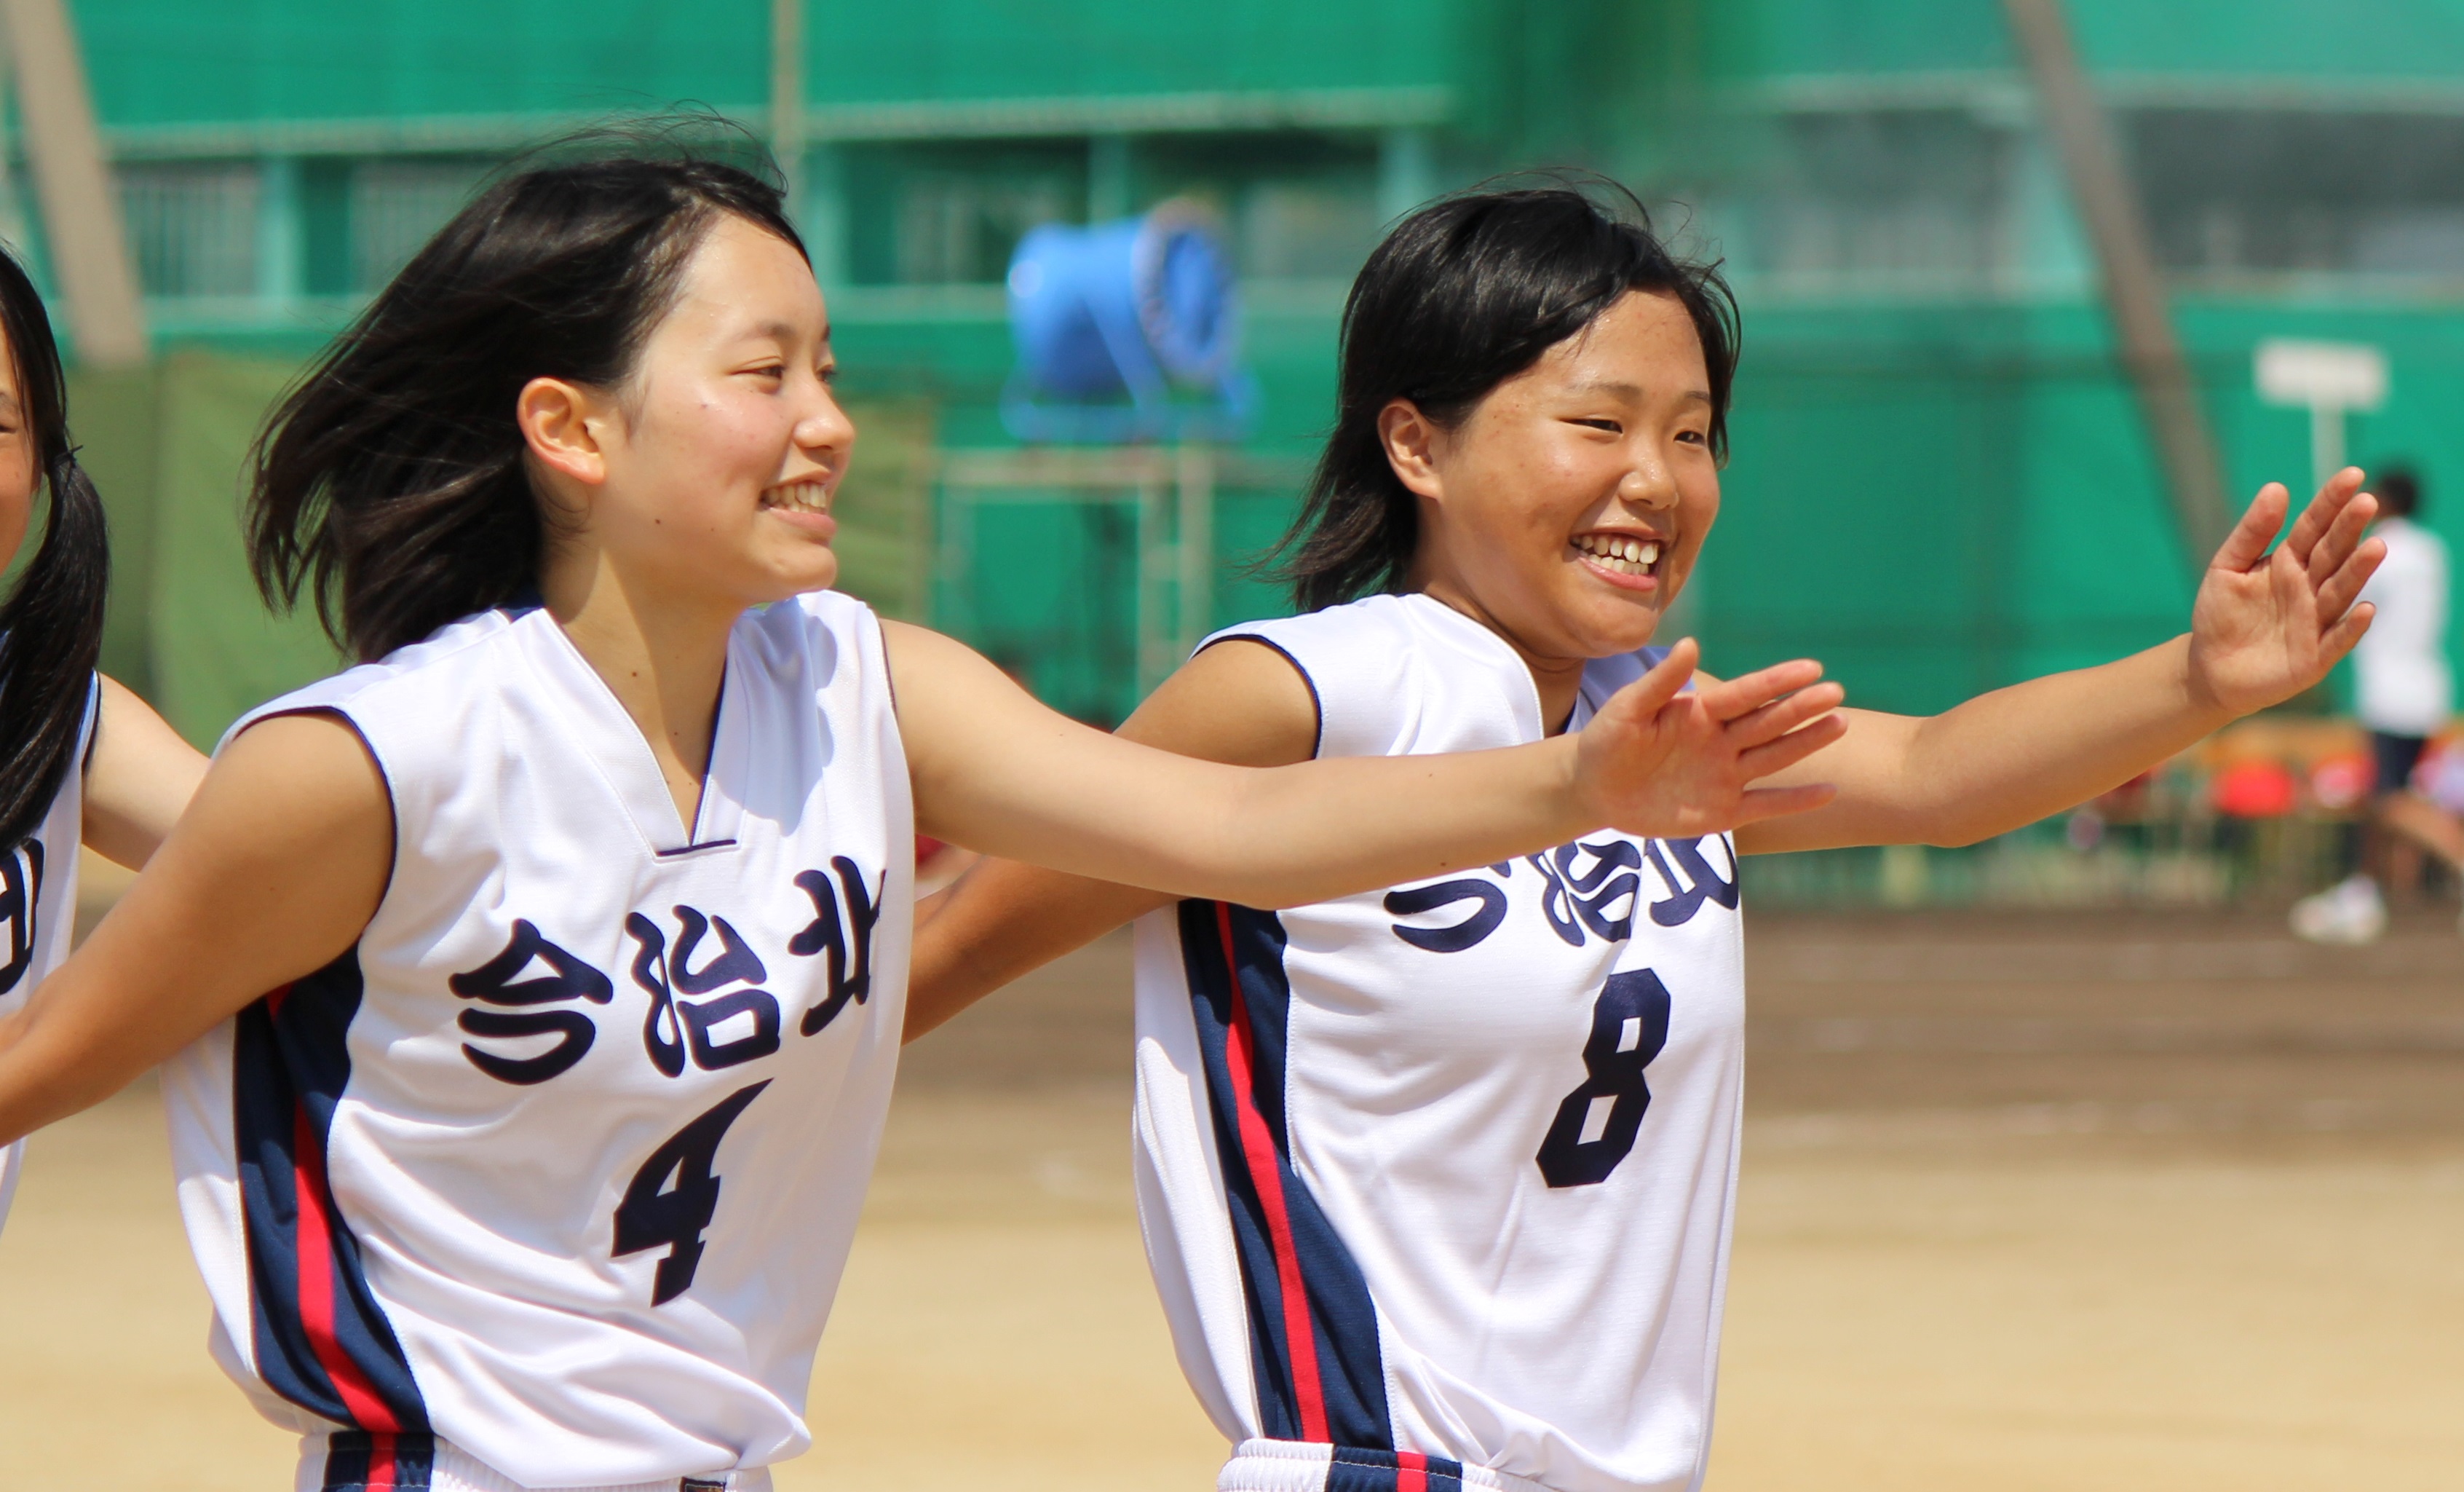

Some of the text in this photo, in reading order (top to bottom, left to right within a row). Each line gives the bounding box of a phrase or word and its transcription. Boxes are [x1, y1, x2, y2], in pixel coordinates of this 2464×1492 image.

[448, 855, 887, 1085] 今治北
[1536, 968, 1671, 1188] 8
[611, 1077, 775, 1308] 4
